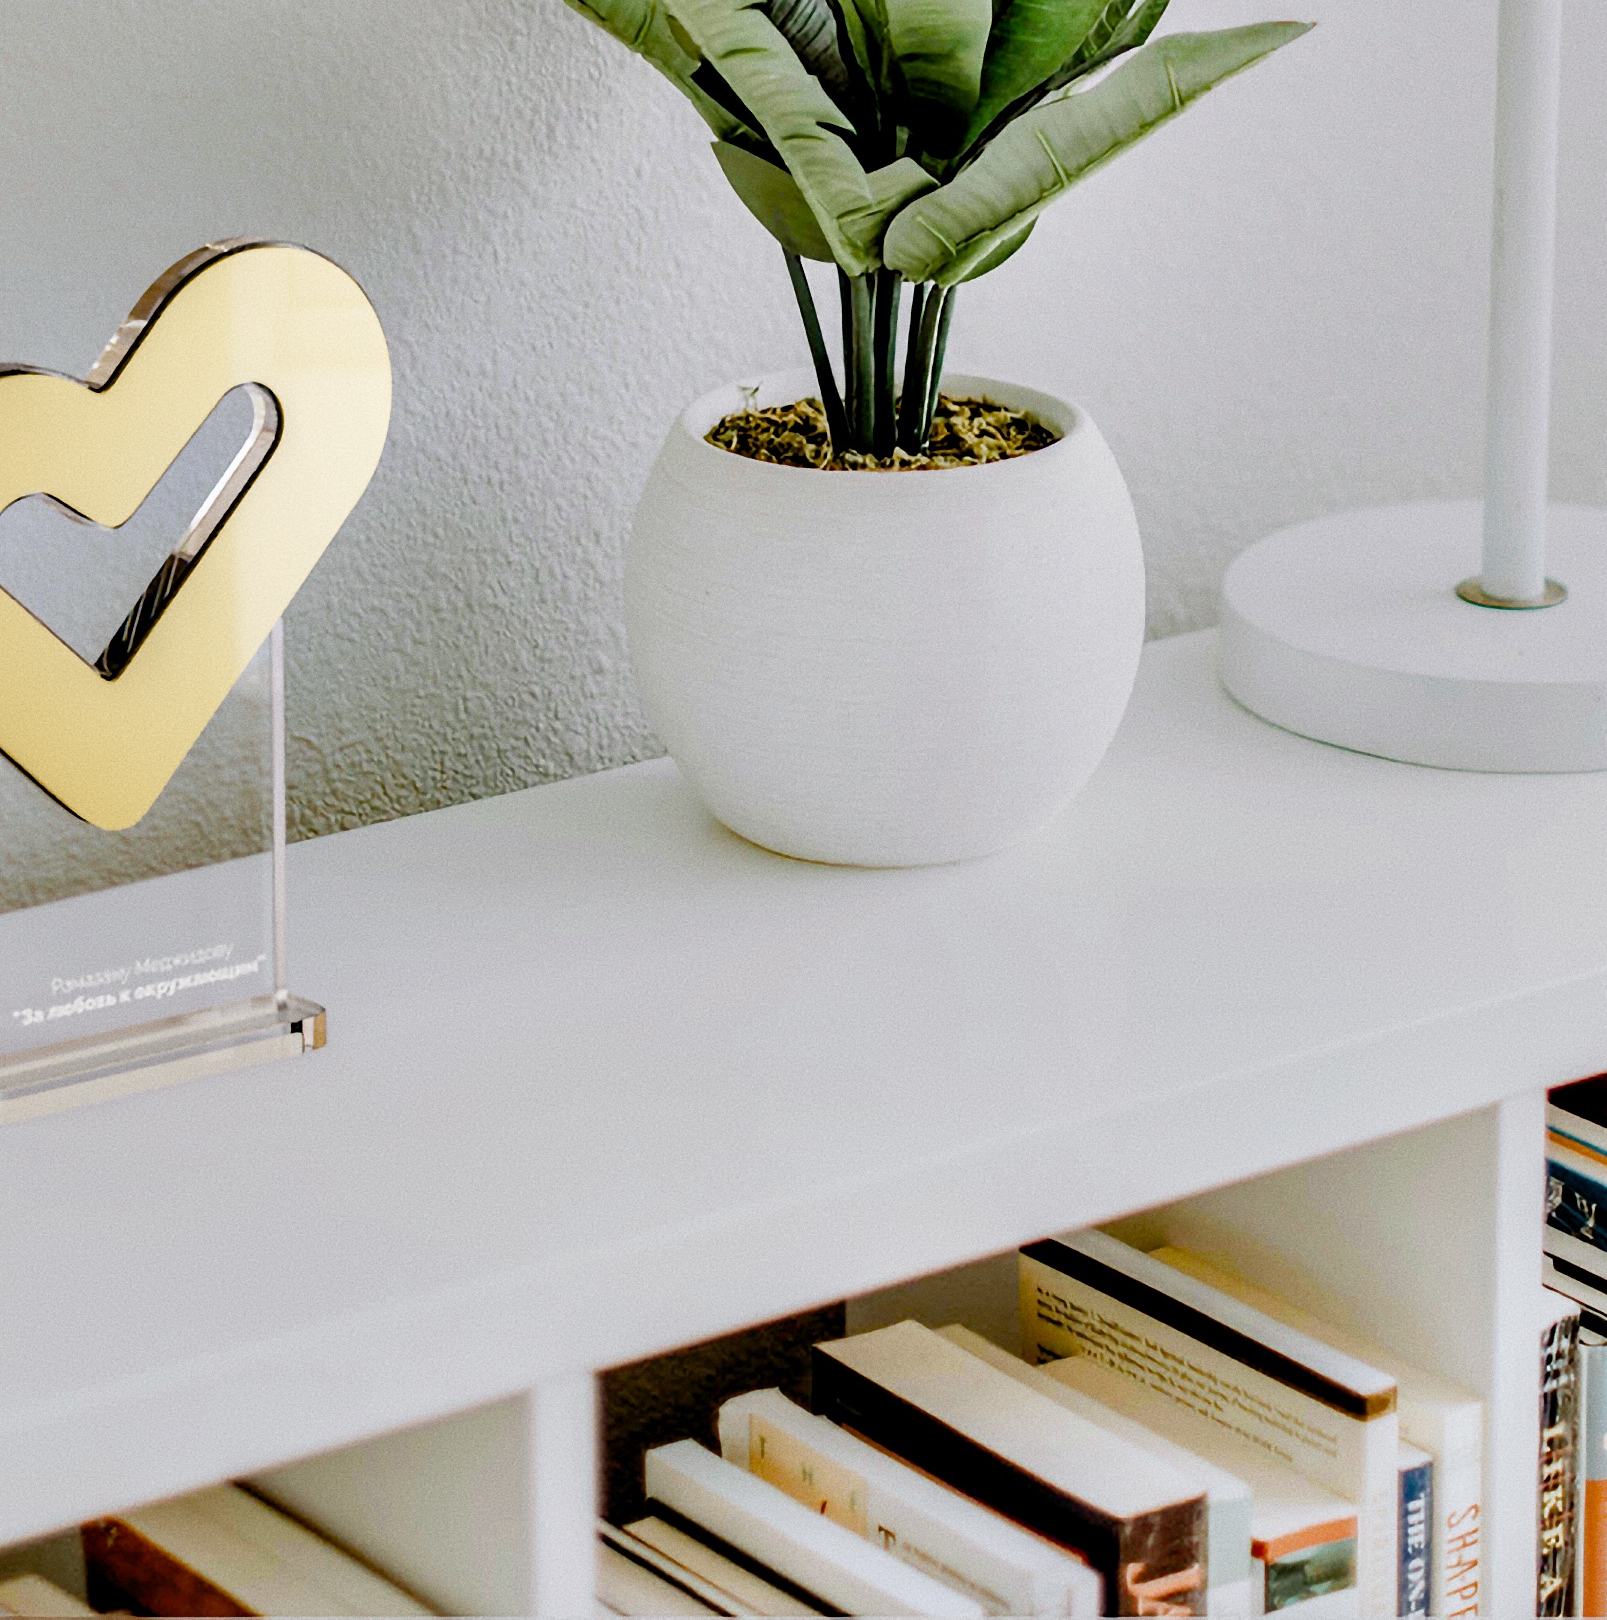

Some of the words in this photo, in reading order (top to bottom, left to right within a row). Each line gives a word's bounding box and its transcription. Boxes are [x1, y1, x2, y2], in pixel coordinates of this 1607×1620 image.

[1540, 1421, 1569, 1556] LIKE
[1406, 1492, 1427, 1555] THE
[1539, 1574, 1564, 1604] A
